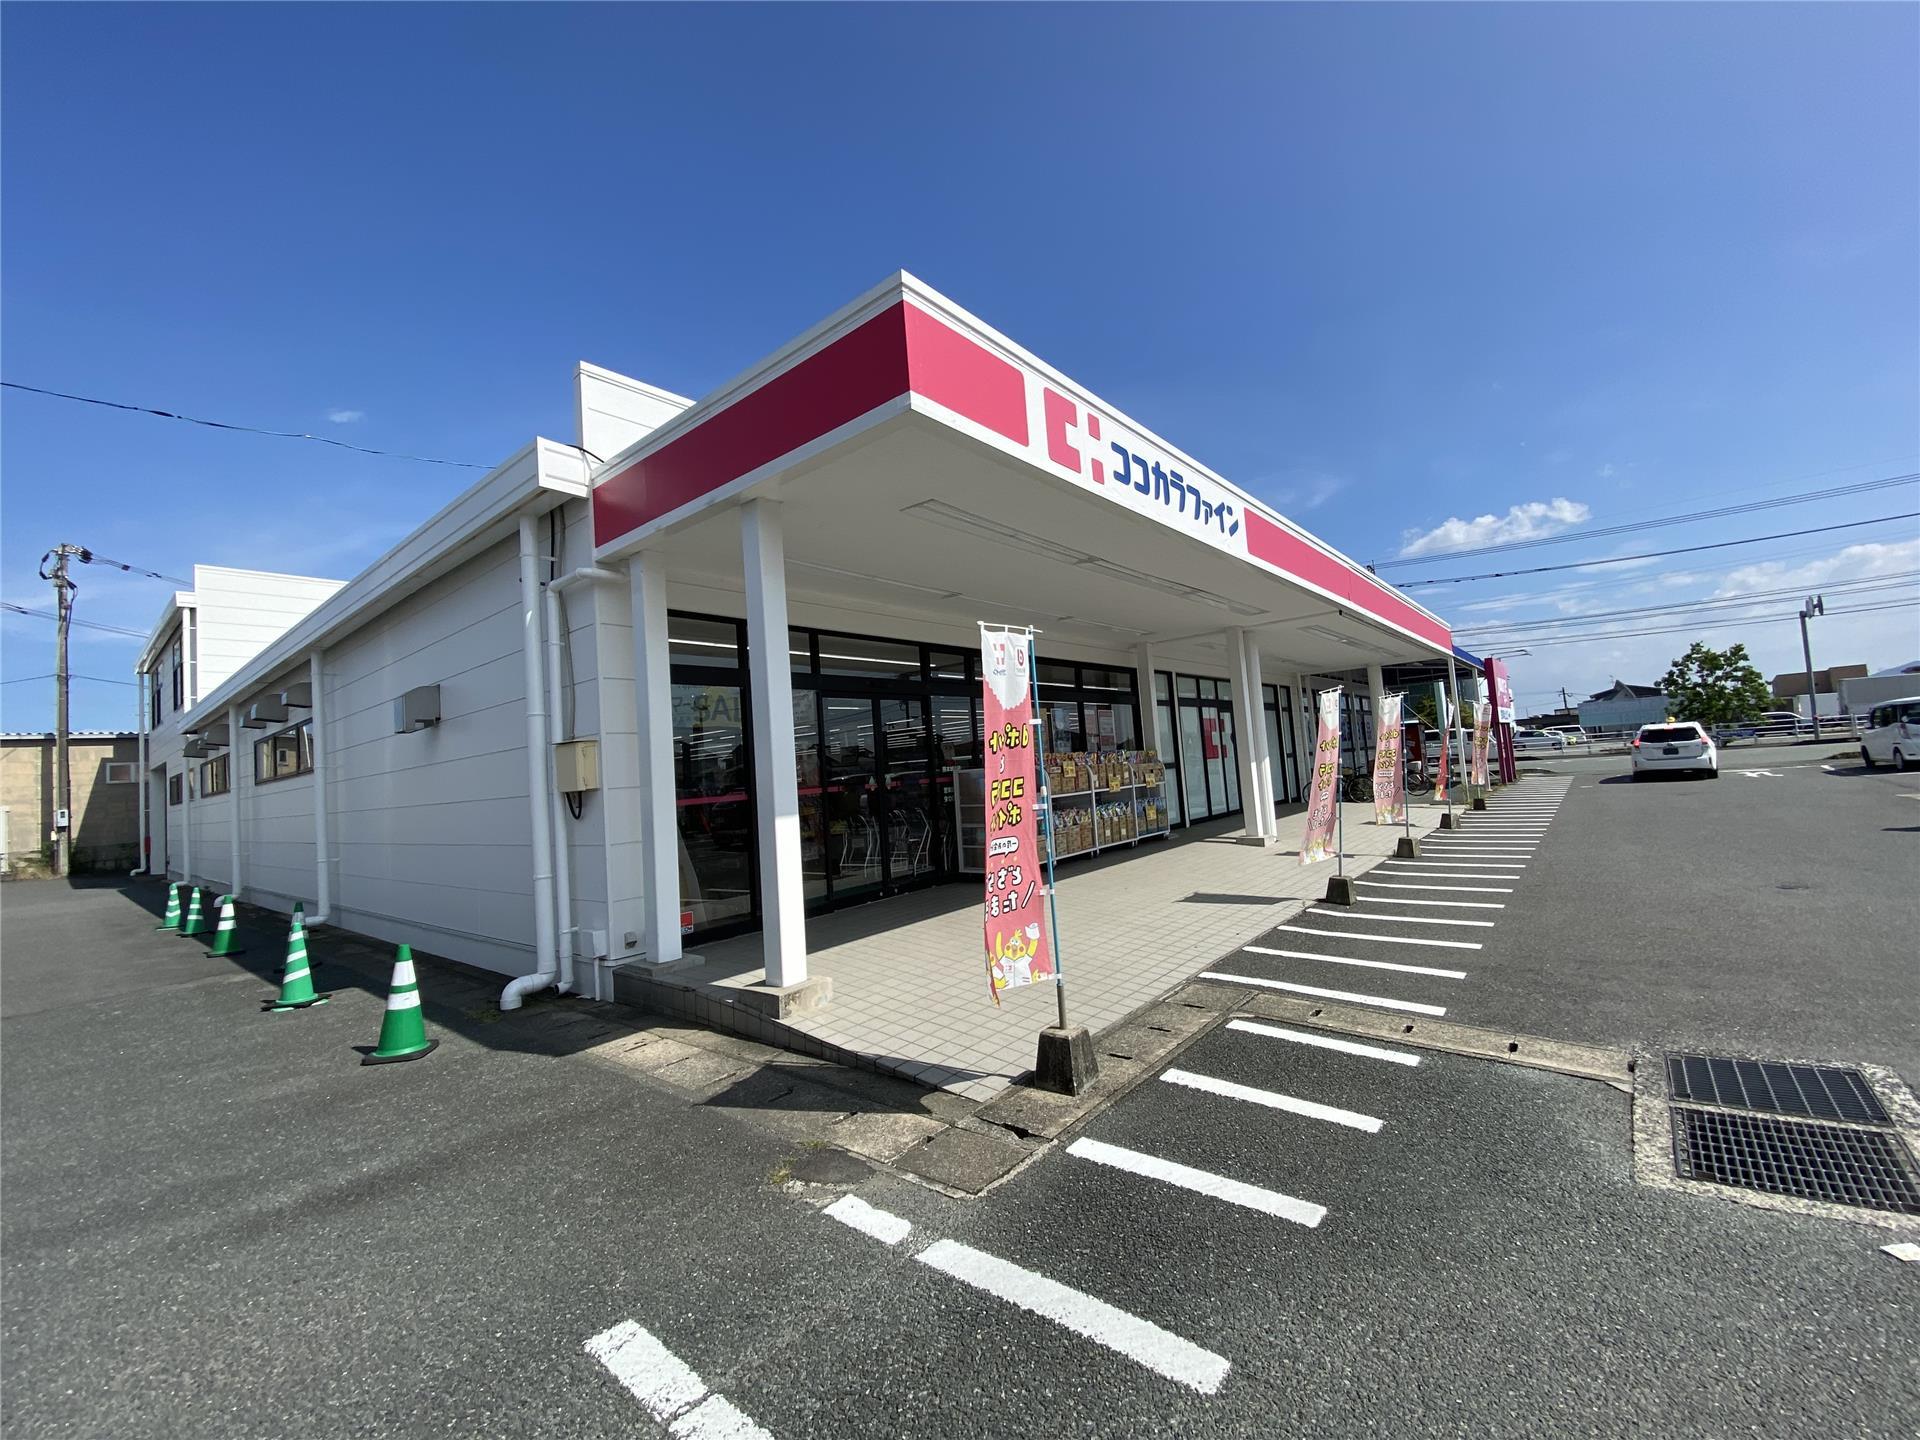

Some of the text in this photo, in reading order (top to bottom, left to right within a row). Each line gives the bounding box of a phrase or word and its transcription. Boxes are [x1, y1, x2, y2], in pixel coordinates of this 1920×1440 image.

[1110, 441, 1239, 537] ココカラファイン
